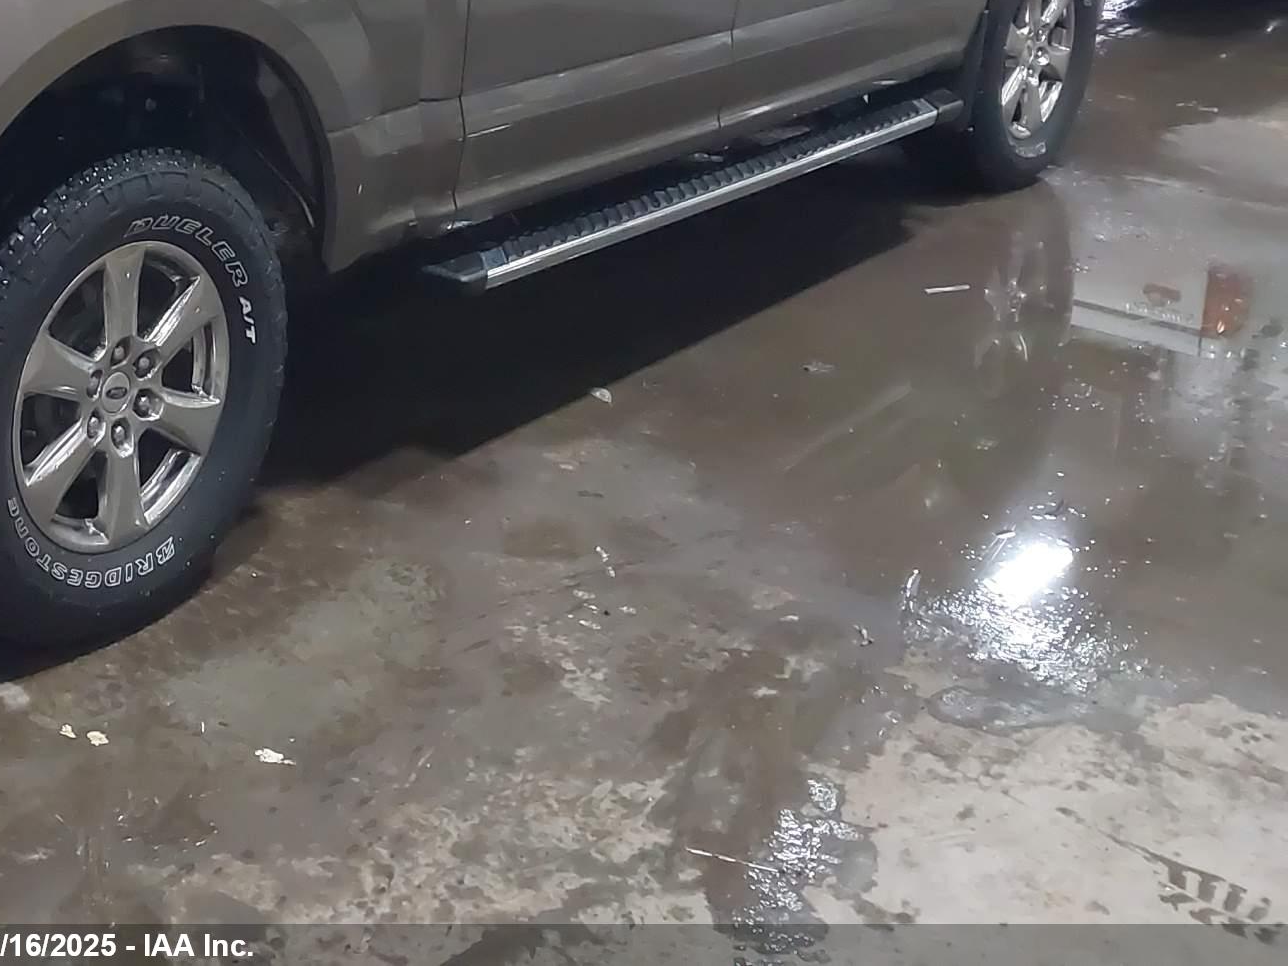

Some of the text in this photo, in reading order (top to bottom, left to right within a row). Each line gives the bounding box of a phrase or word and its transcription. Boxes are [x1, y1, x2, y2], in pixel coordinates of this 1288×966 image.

[123, 214, 257, 344] DUELER A/T
[7, 497, 175, 589] BRIDGESTONE
